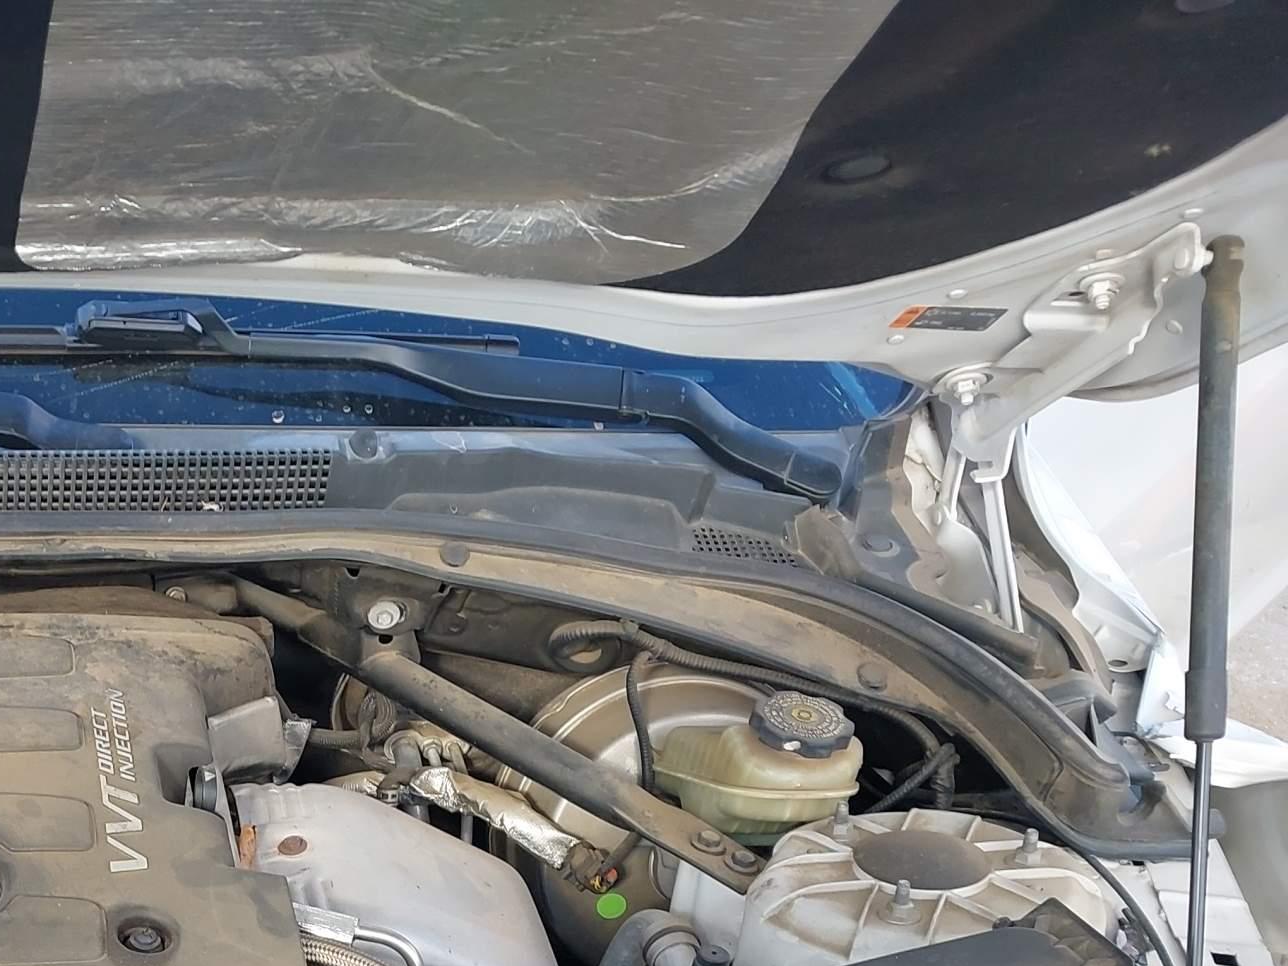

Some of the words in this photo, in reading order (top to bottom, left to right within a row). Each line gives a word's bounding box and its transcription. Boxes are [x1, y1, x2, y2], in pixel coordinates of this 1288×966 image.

[90, 706, 115, 775] DIRECT
[107, 687, 137, 782] INJECTION
[99, 774, 149, 873] VVT
